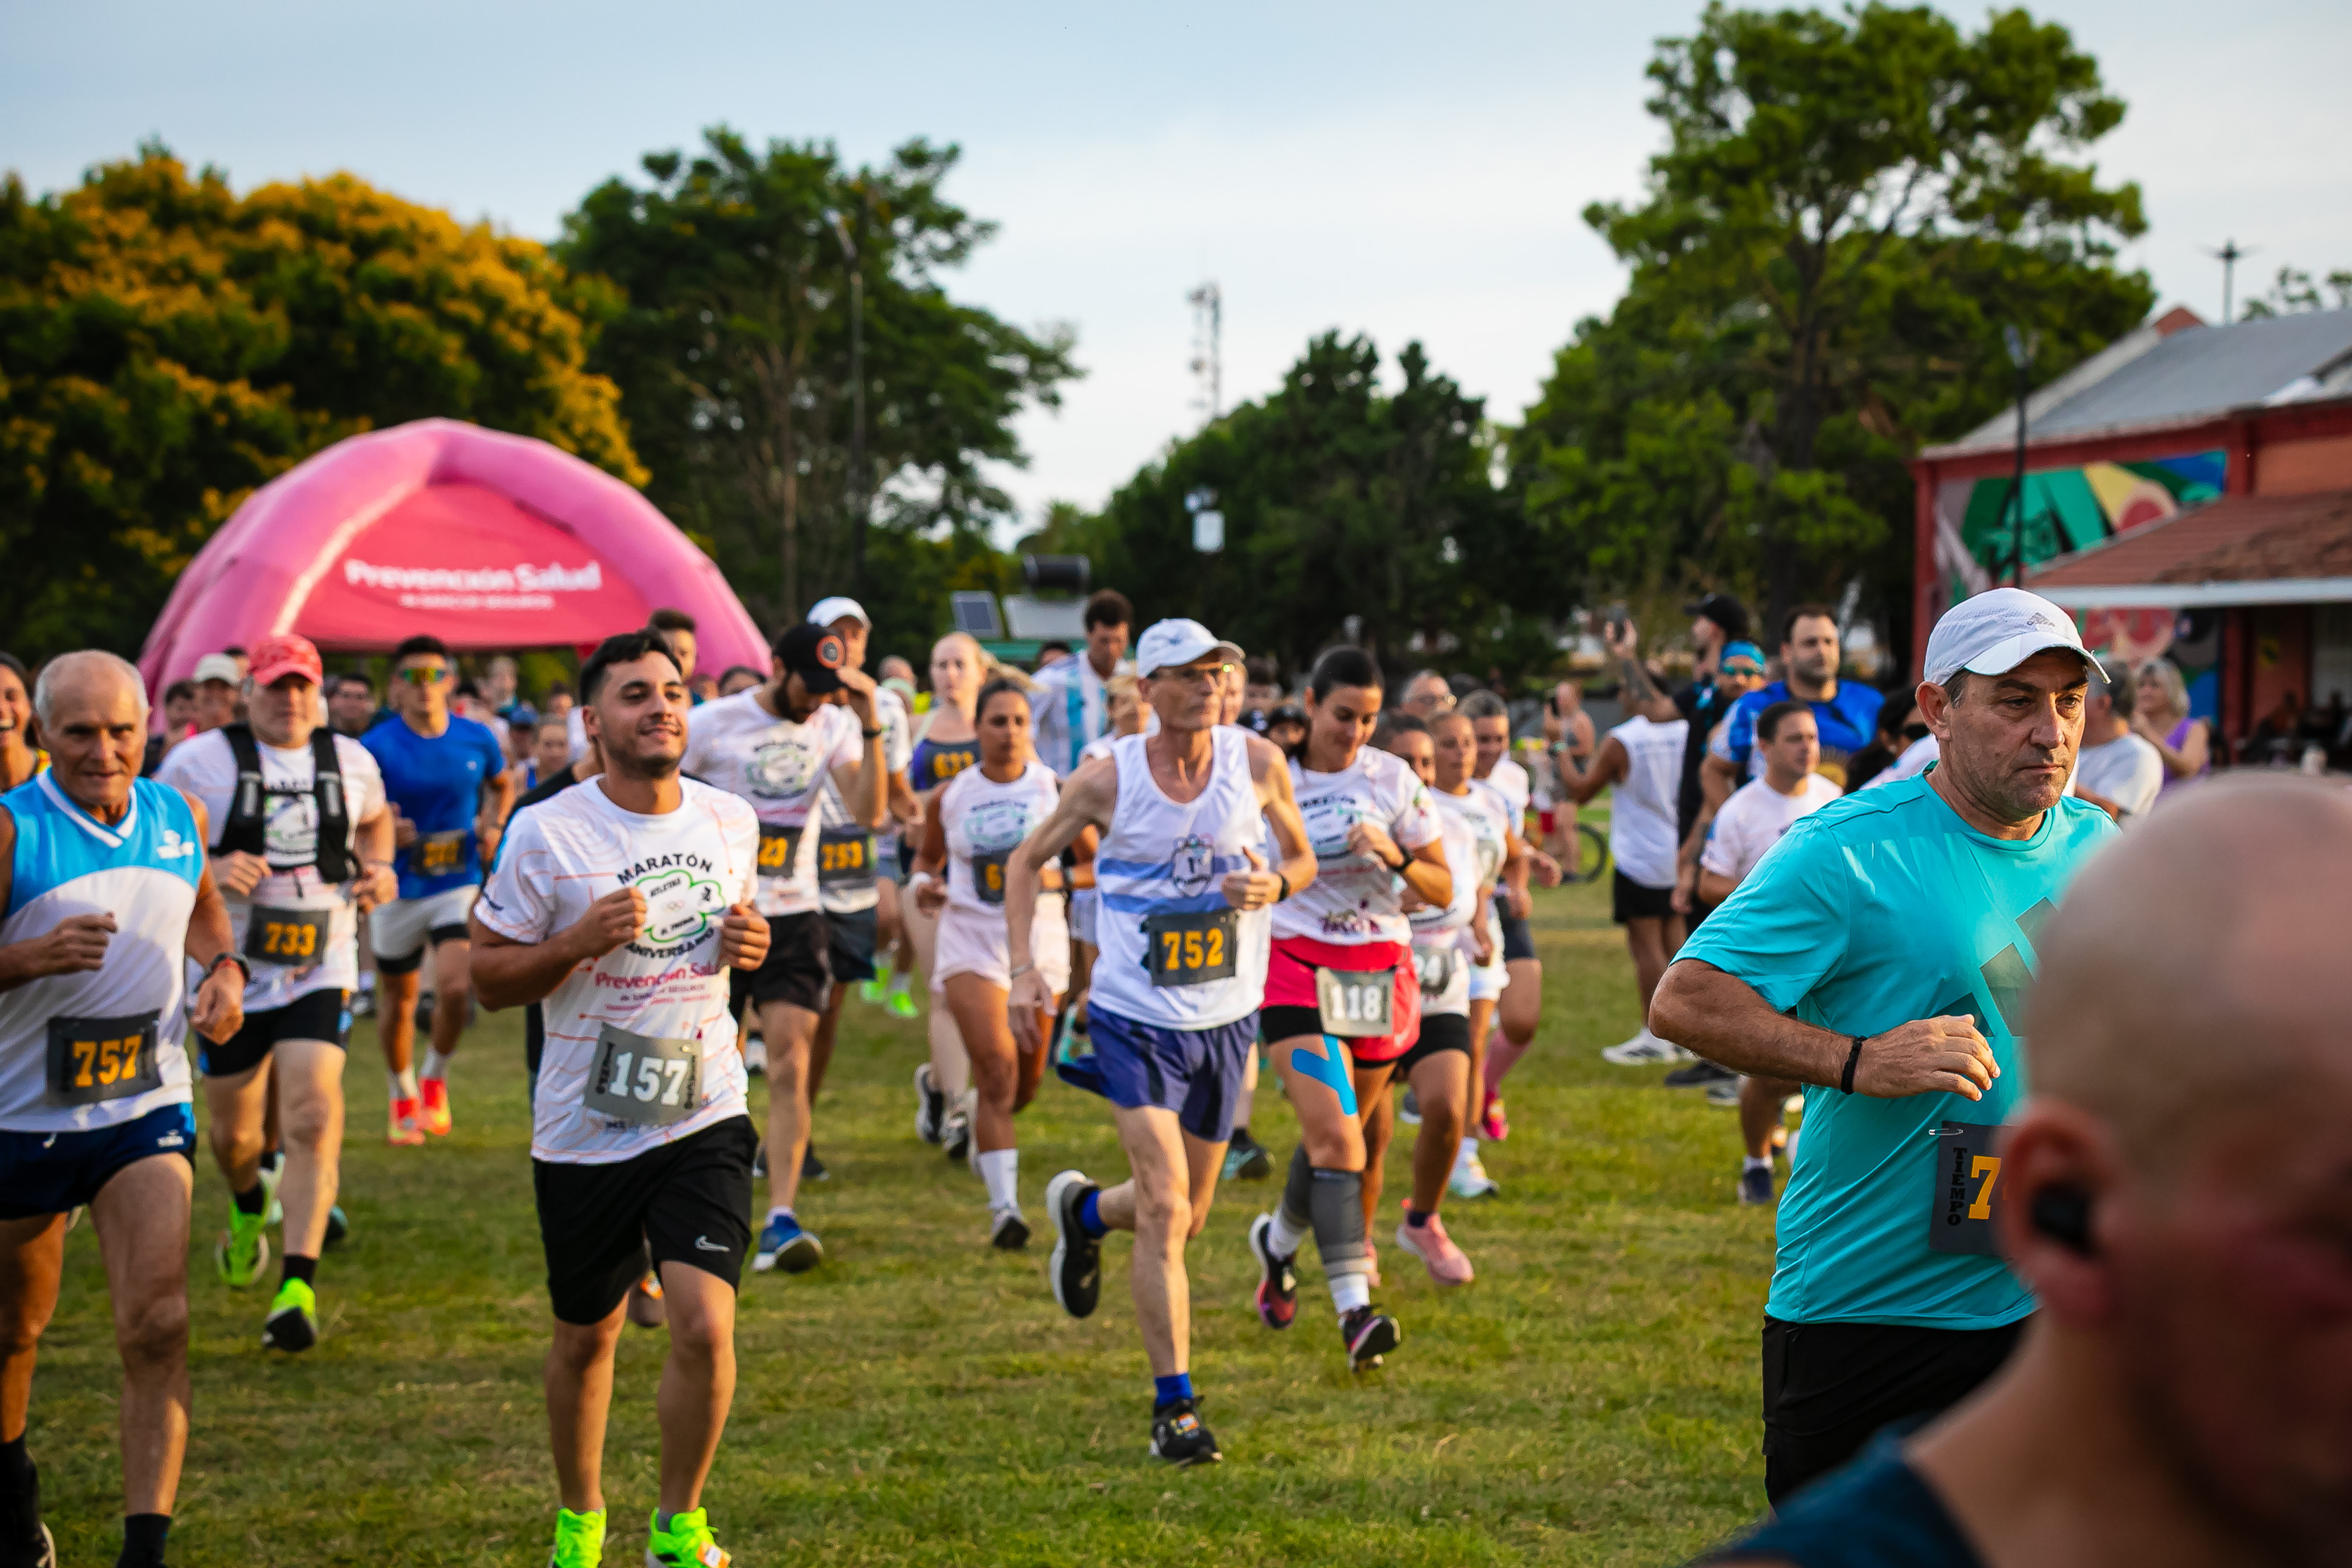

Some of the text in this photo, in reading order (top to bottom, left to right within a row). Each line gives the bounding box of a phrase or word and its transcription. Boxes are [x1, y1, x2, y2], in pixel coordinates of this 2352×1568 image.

[515, 561, 602, 592] Salud
[616, 850, 712, 886] MARATÓN
[1162, 927, 1224, 971] 752
[1330, 985, 1382, 1022] 118
[72, 1034, 142, 1088] 757
[609, 1052, 688, 1107] 157
[1947, 1147, 1968, 1226] TIEMPO
[1968, 1155, 2005, 1220] 7
